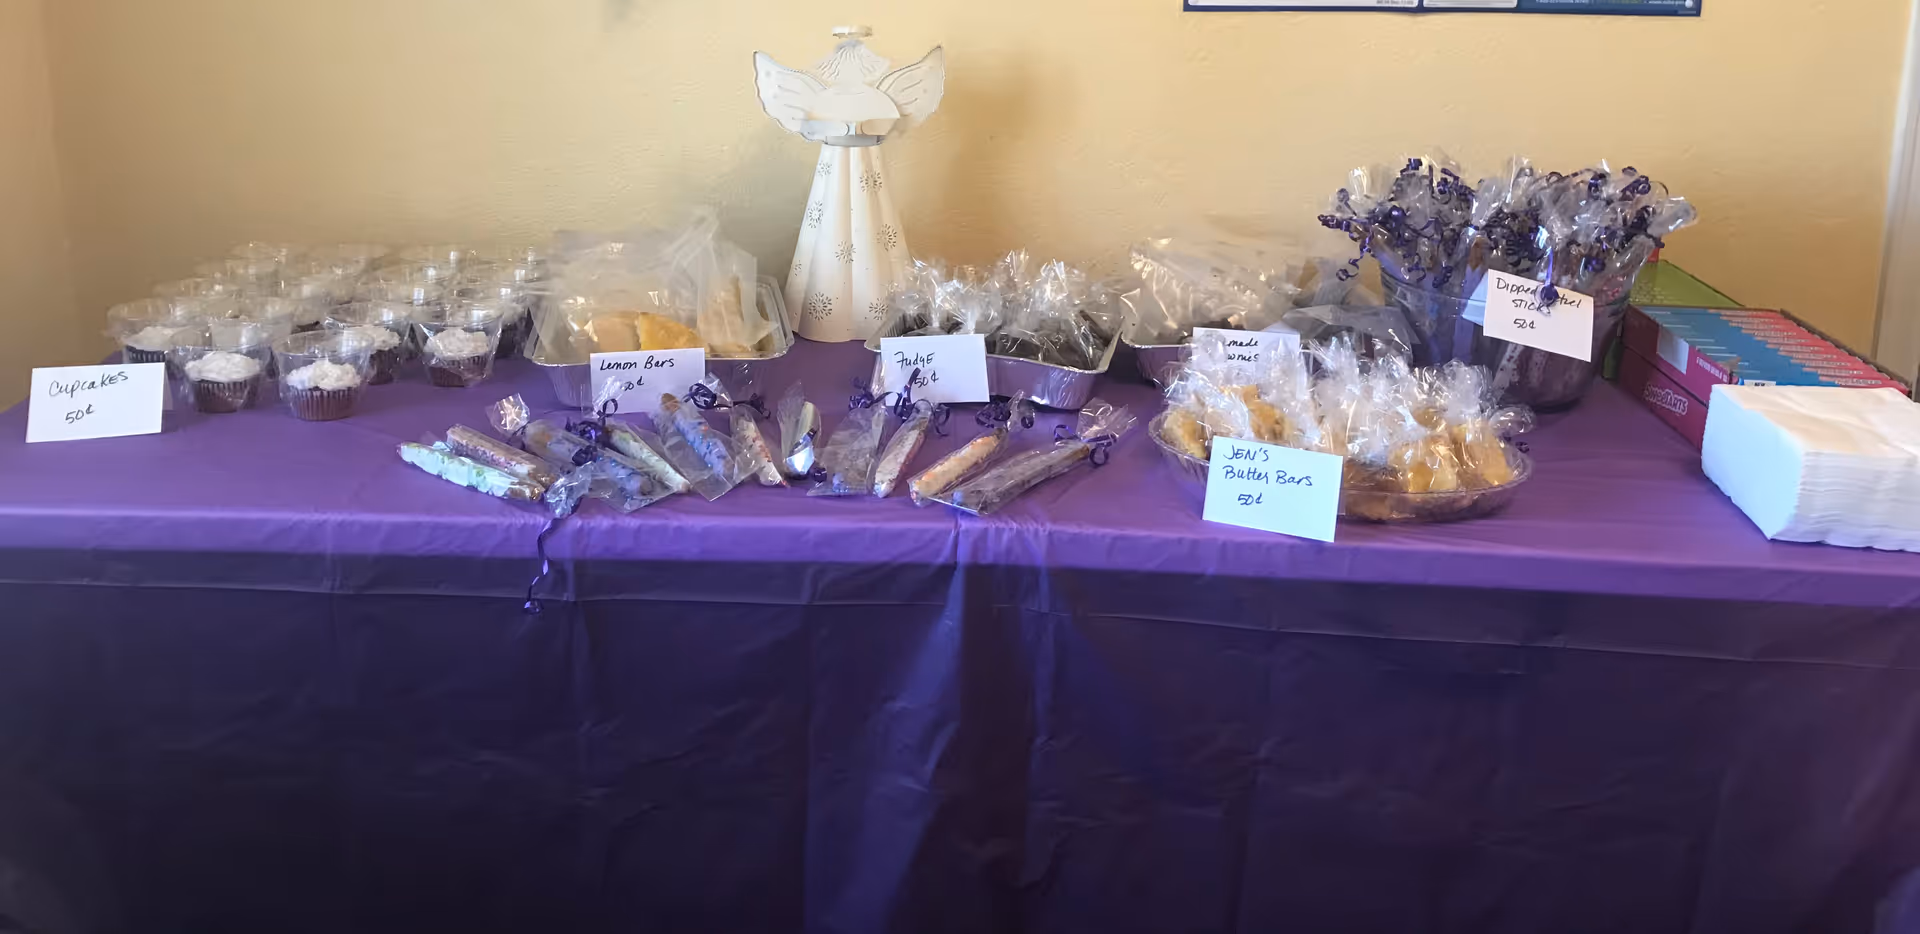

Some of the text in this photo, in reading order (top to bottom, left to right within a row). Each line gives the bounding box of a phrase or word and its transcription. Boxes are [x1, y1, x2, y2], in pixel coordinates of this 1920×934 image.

[1496, 278, 1537, 295] Dipped
[1513, 318, 1536, 329] 50¢
[600, 355, 675, 371] Lemon Bars
[1227, 350, 1260, 362] wnies
[914, 370, 939, 388] 50¢
[65, 404, 95, 424] 50¢
[1223, 444, 1269, 462] JEN'S
[1222, 465, 1313, 486] Butter Bars
[1237, 492, 1263, 506] 50¢
